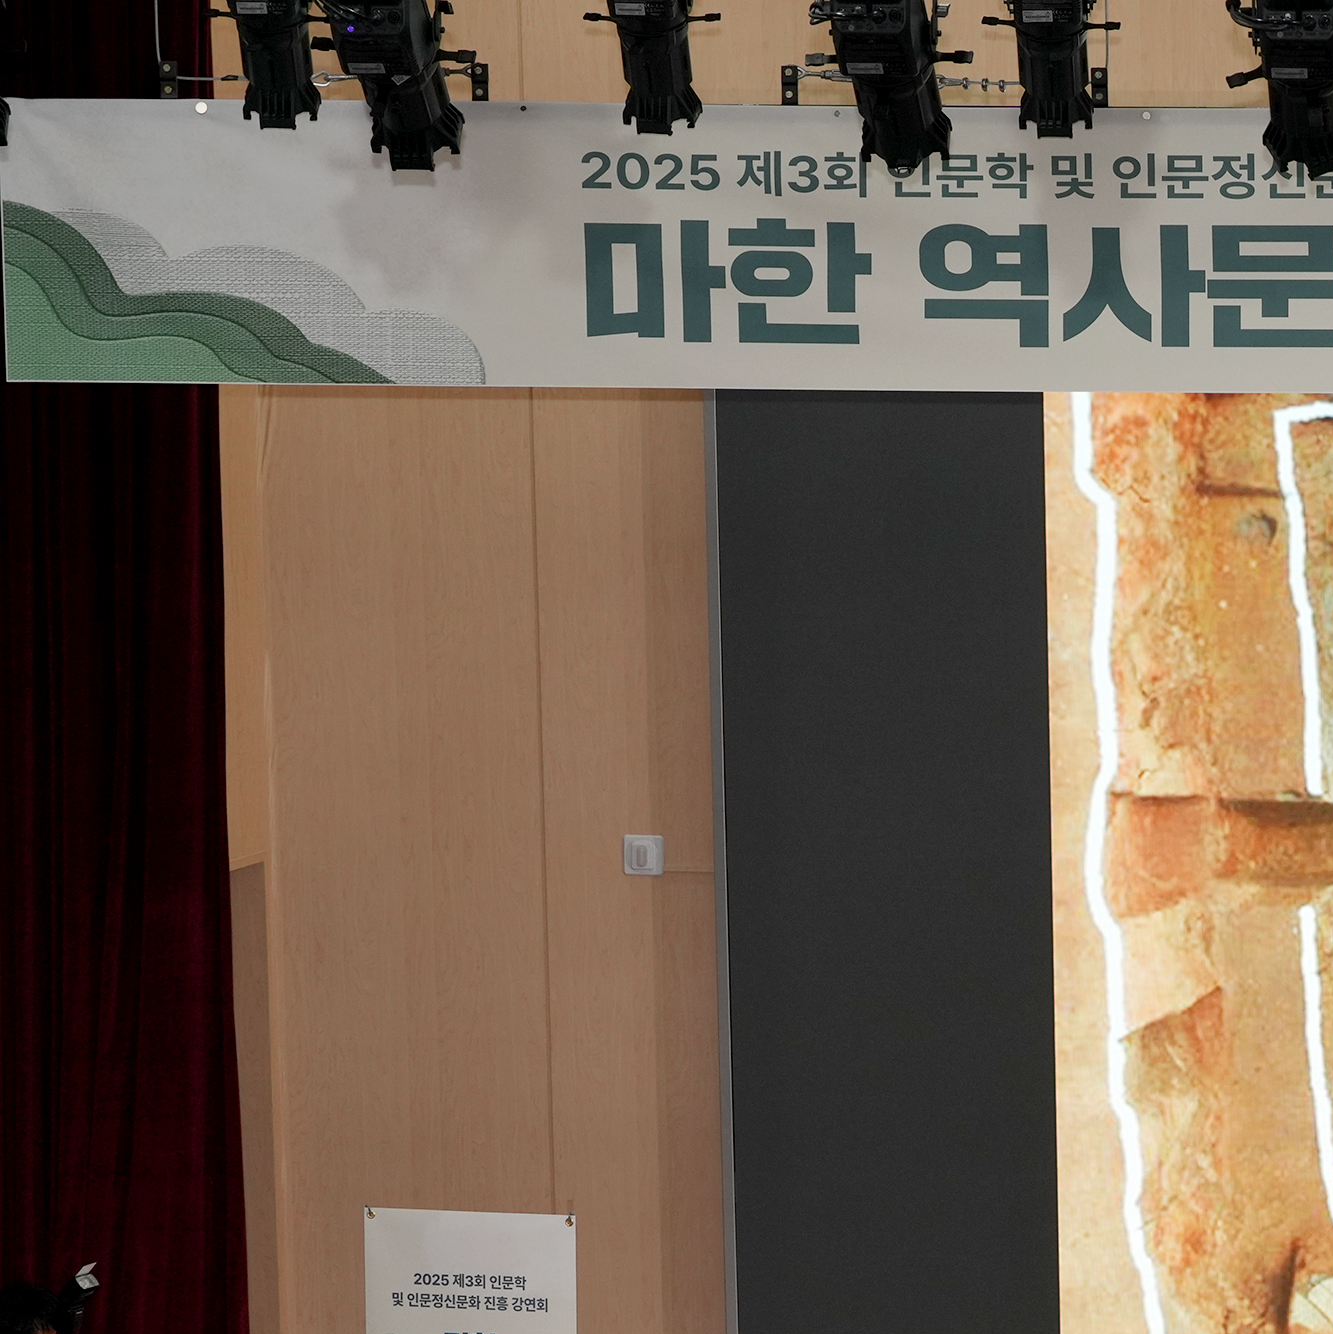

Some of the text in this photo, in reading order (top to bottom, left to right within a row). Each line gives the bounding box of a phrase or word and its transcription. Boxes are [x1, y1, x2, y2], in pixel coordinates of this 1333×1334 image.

[582, 152, 720, 191] 2025
[737, 150, 867, 199] 제3회
[1052, 153, 1094, 199] 및
[584, 218, 872, 344] 마한
[413, 1273, 526, 1290] 2025 제3회 인문학
[392, 1292, 548, 1312] 및 인문정신문화 진흥 강연회
